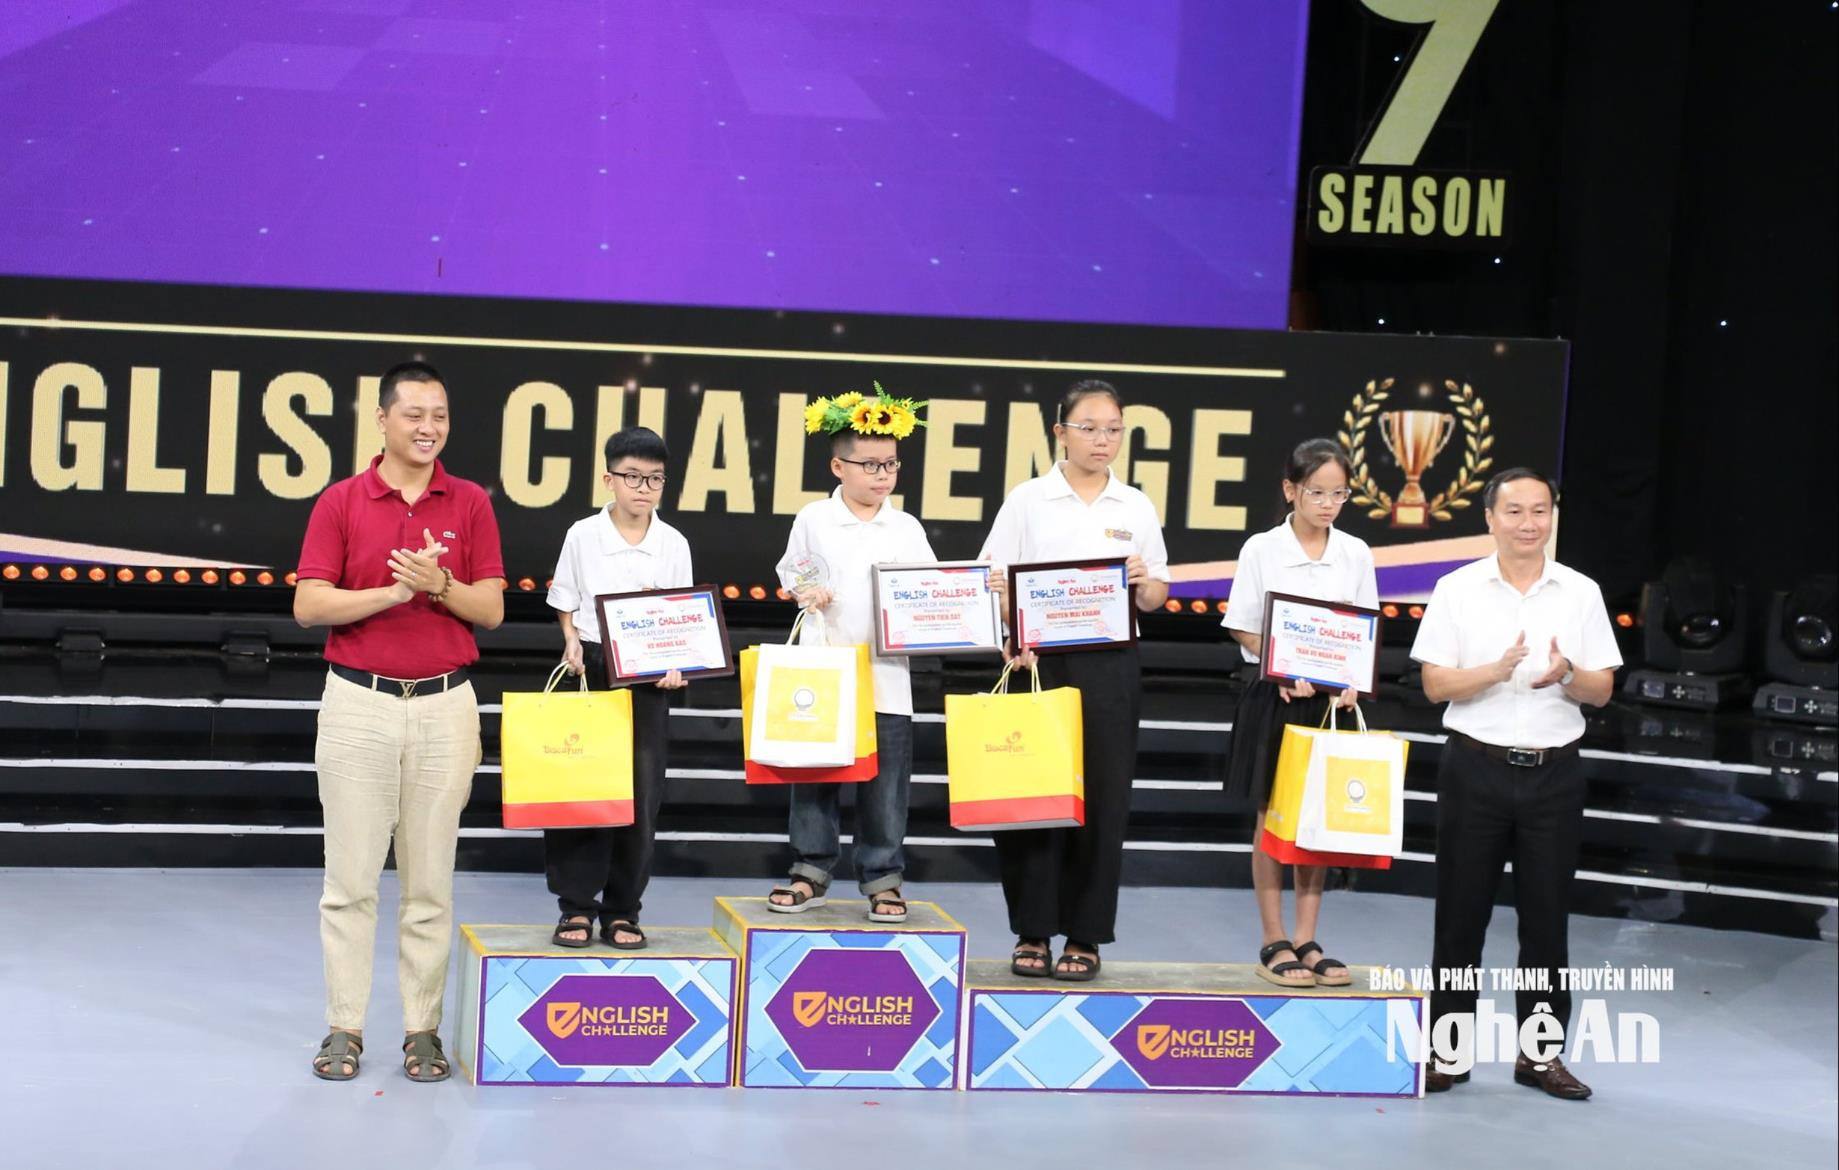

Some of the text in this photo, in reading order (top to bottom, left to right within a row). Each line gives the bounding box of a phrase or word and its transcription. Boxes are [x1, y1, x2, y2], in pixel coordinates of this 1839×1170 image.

[1318, 172, 1505, 237] SEASON
[500, 381, 1253, 531] CHALENGE
[893, 588, 977, 600] ENGLISH CHALLENGE
[1030, 584, 1115, 599] ENGLISH CHALLENGE
[621, 614, 704, 630] ENGLISH CHALLENGE
[1283, 621, 1362, 642] ENGLISH CHALLENGE
